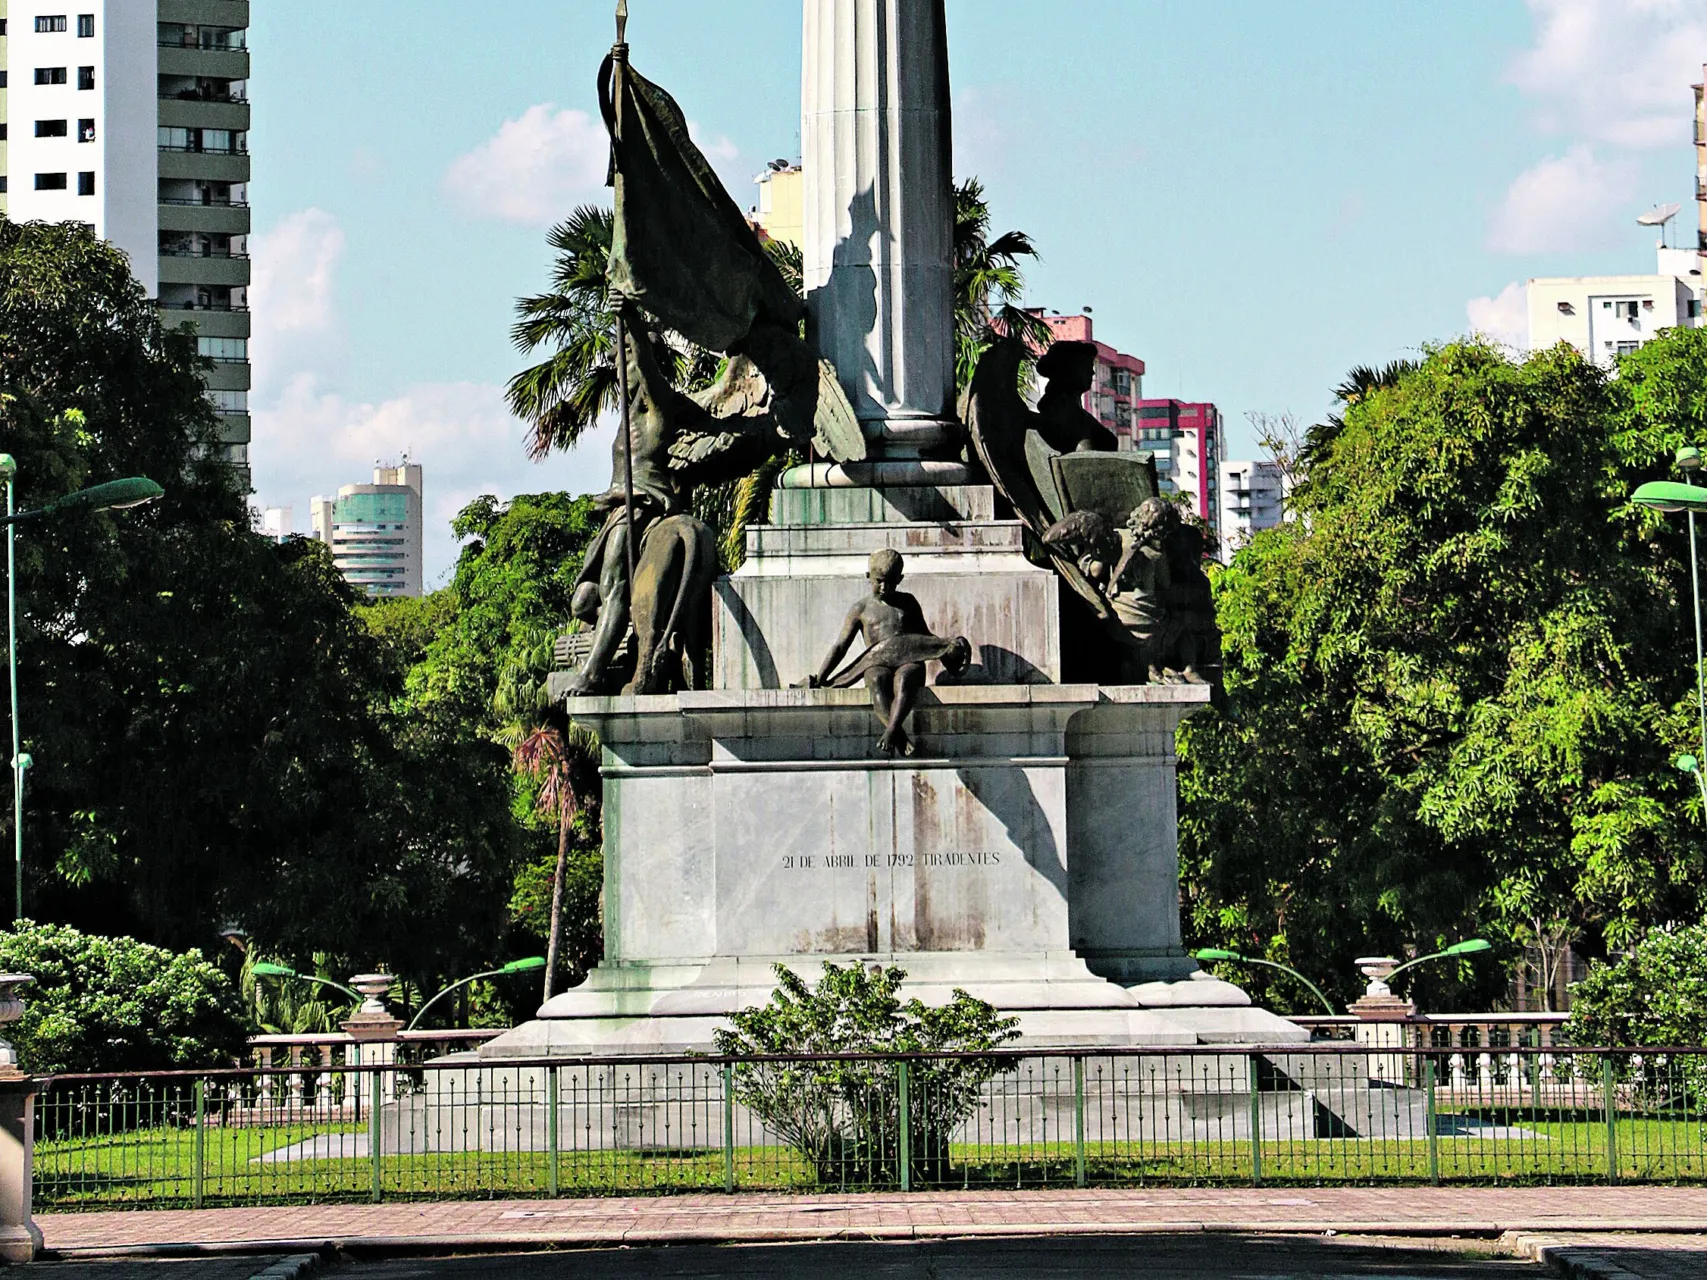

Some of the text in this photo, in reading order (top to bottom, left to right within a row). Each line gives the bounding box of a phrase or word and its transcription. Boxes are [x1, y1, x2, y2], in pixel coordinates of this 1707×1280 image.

[782, 852, 1000, 869] 21 DE ABRIL DE 1792 TIRADENTES
